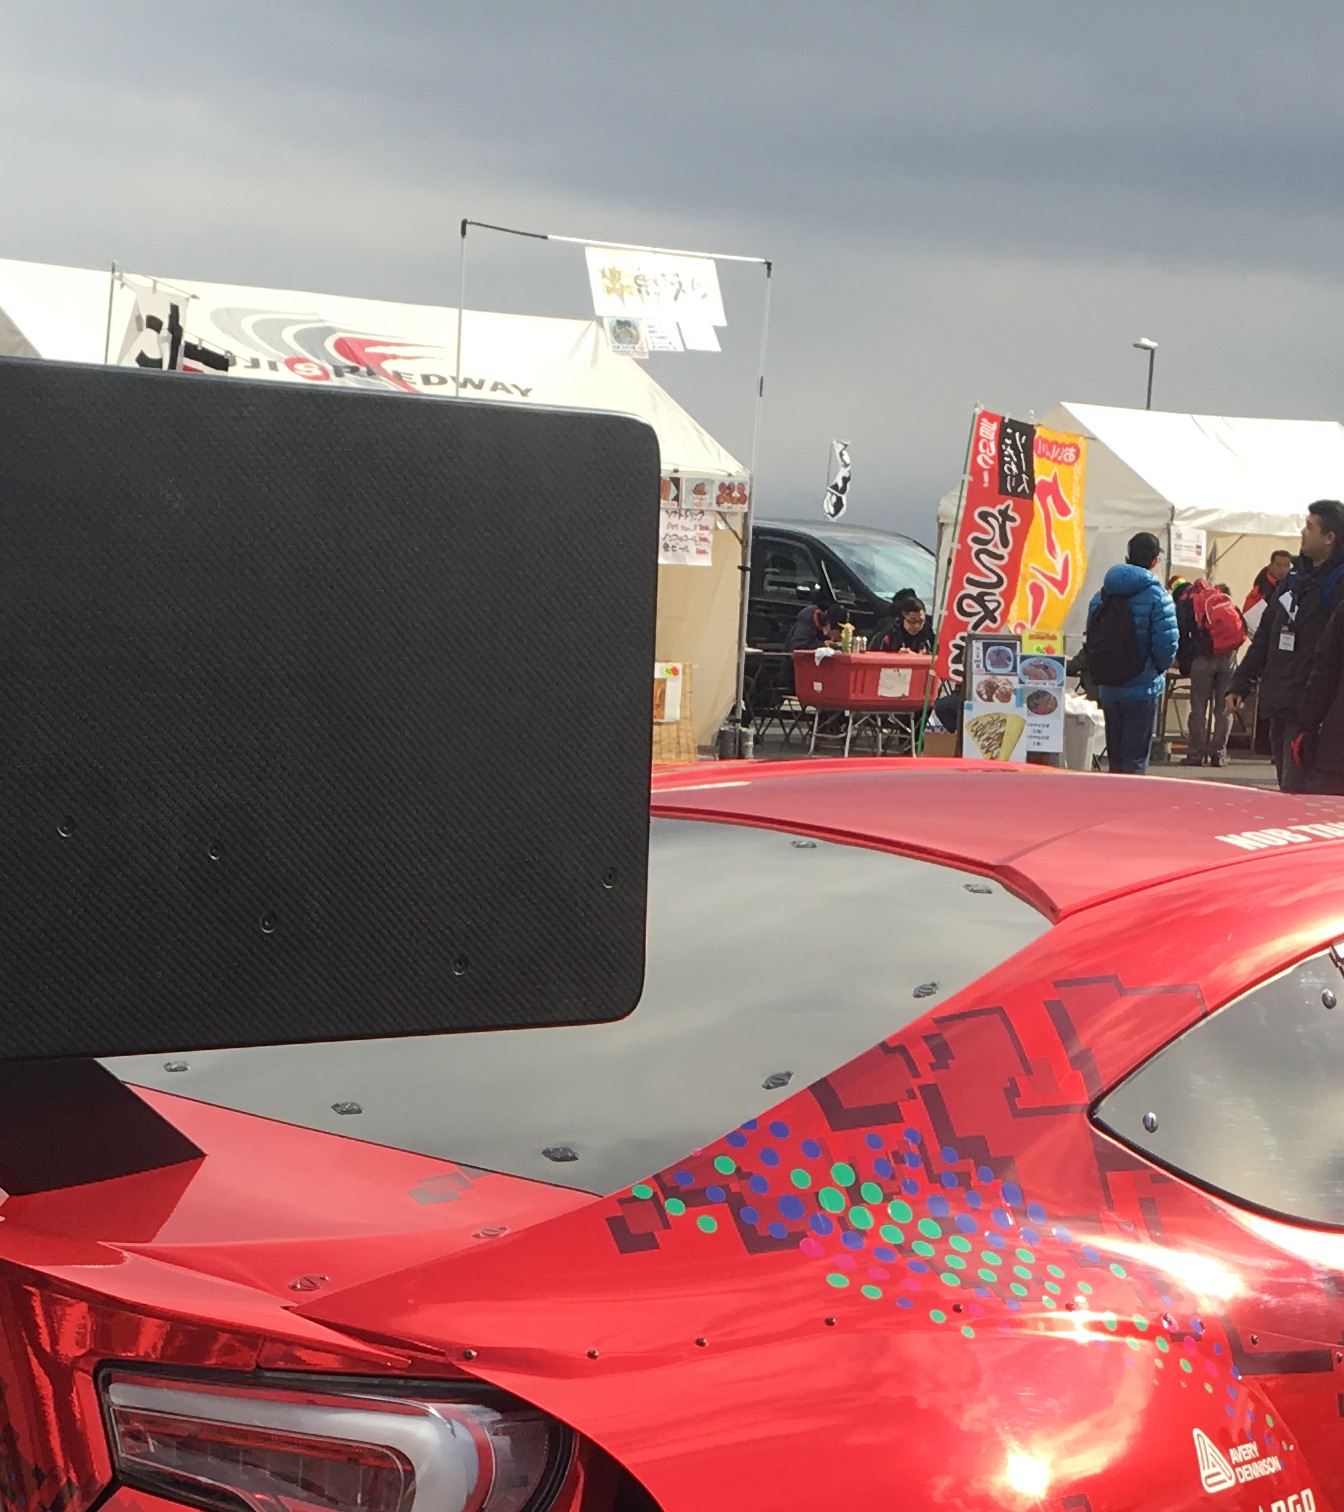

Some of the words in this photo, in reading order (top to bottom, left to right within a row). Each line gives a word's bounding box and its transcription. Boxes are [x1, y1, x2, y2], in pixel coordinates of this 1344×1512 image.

[1214, 828, 1313, 850] NOB
[1228, 1441, 1260, 1465] AVERY
[1234, 1455, 1282, 1484] DENNISON
